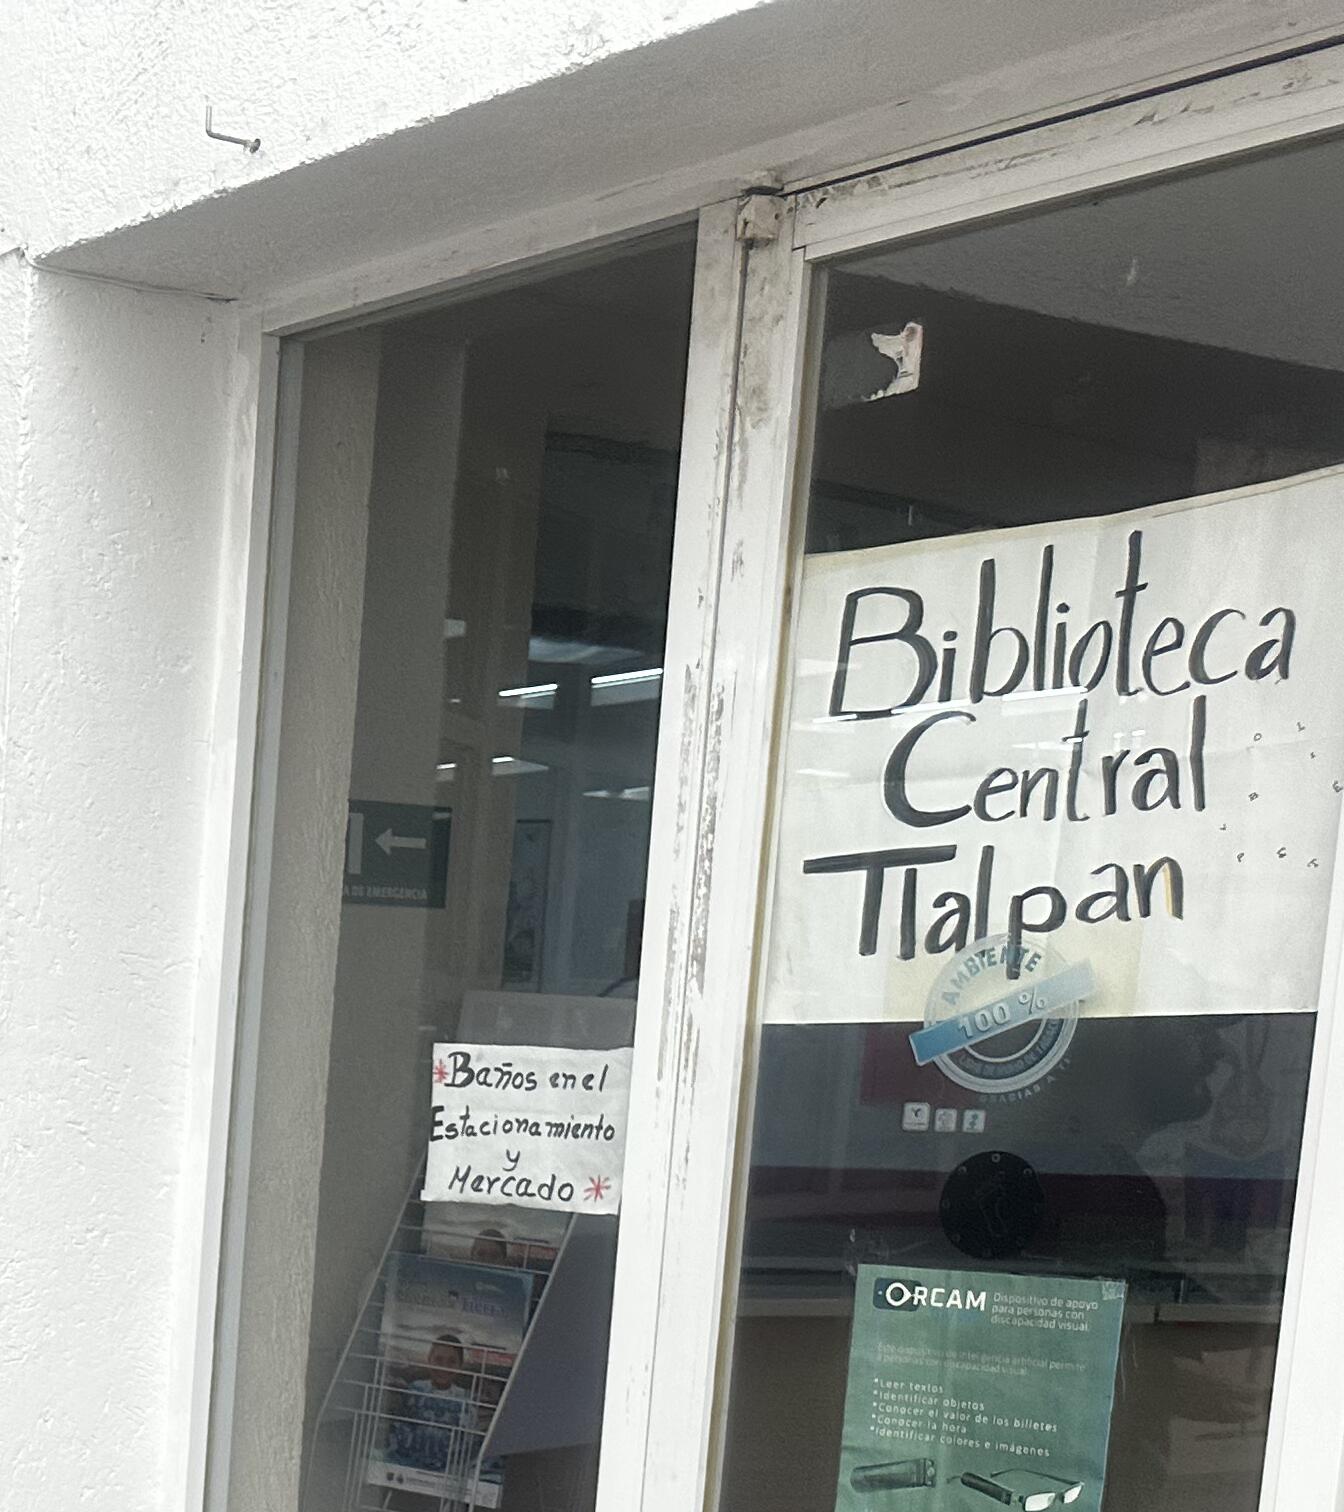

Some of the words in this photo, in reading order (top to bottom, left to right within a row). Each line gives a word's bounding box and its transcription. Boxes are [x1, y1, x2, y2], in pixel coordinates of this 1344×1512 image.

[828, 529, 1297, 721] Biblioteca
[883, 694, 1207, 828] Central
[803, 845, 1185, 981] Tlalpan
[957, 1002, 1011, 1040] 100
[1018, 986, 1048, 1015] %
[443, 1050, 538, 1091] Baños
[549, 1072, 576, 1090] en
[581, 1064, 609, 1092] el
[429, 1104, 615, 1142] Estacionamiento
[502, 1148, 521, 1171] y
[447, 1164, 575, 1201] Mercado
[878, 1391, 939, 1405] Identificar
[942, 1398, 985, 1411] objetos
[879, 1379, 905, 1390] Leer
[909, 1382, 944, 1394] textos
[878, 1402, 924, 1416] Conocer
[928, 1407, 939, 1418] el
[942, 1410, 971, 1422] valor
[974, 1413, 989, 1424] de
[992, 1416, 1010, 1427] los
[1013, 1418, 1058, 1433] billetes
